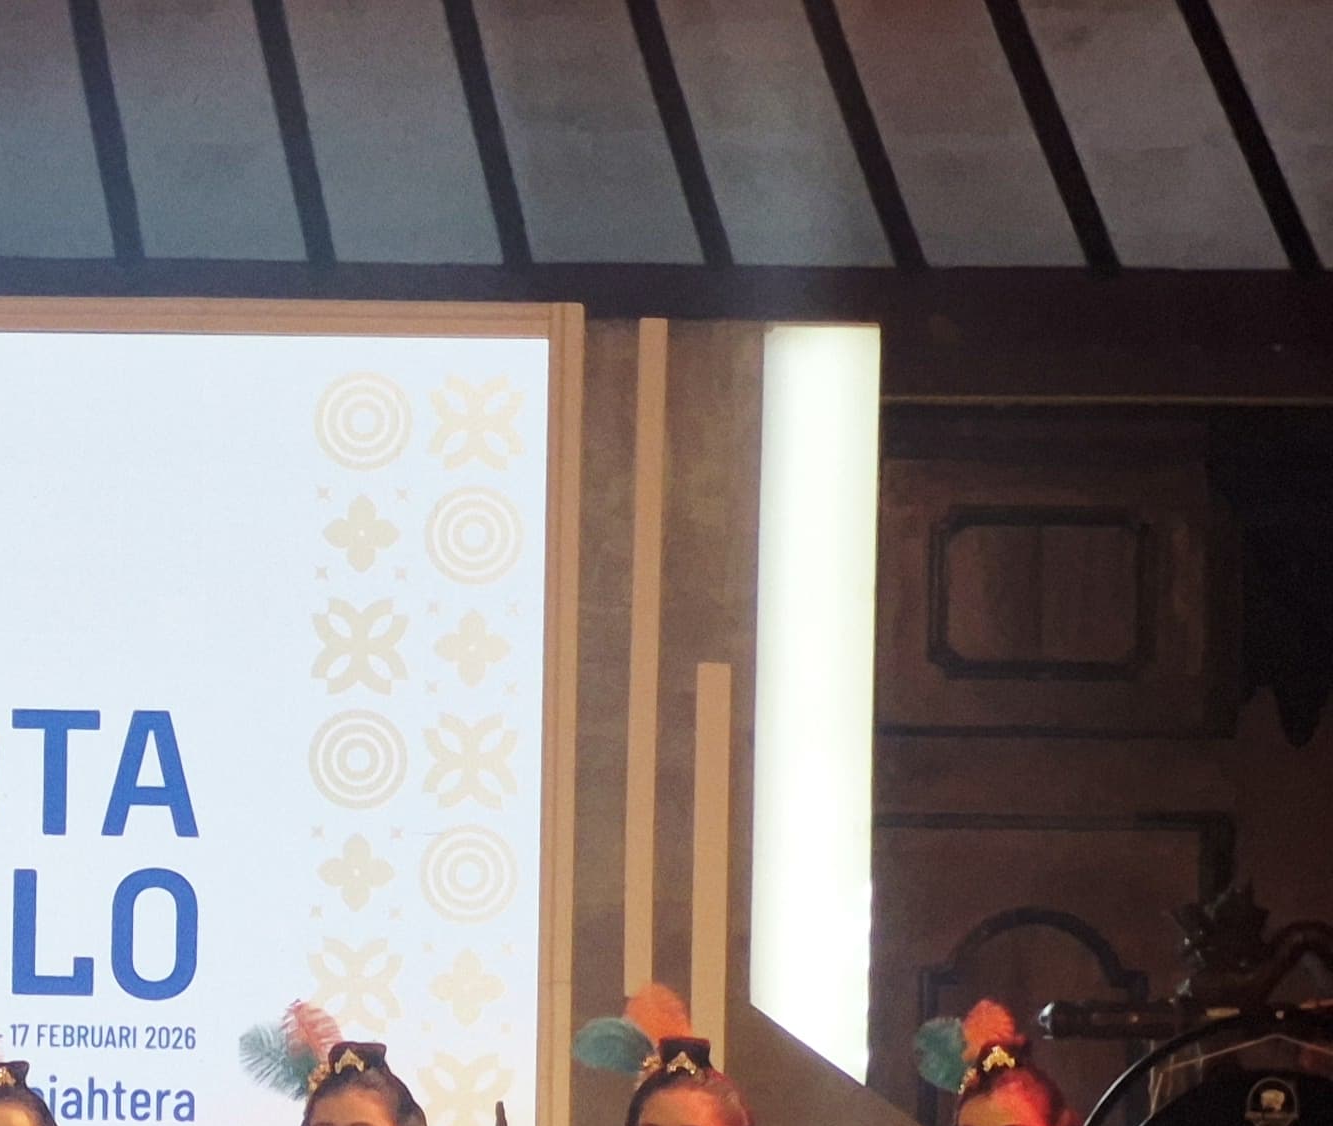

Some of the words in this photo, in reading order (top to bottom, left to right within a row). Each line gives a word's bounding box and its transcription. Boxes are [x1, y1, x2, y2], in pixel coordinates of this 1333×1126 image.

[10, 1023, 30, 1047] 17
[37, 1024, 137, 1049] FEBRUARI
[145, 1025, 196, 1050] 2026
